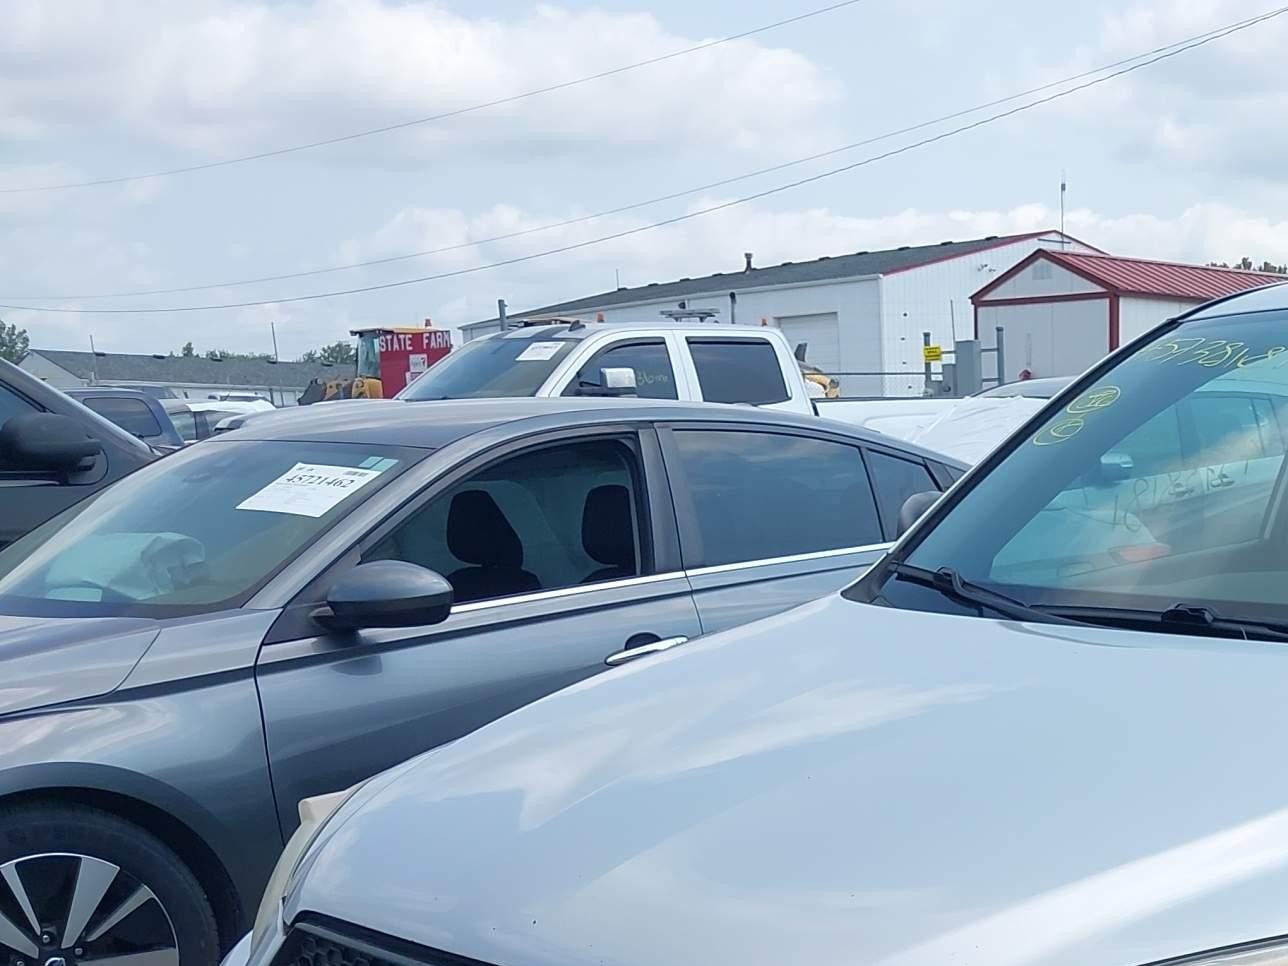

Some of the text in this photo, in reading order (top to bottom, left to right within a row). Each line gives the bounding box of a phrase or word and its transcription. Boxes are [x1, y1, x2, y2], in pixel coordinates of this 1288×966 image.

[380, 332, 450, 352] STATE FARM
[286, 474, 355, 488] 45721462
